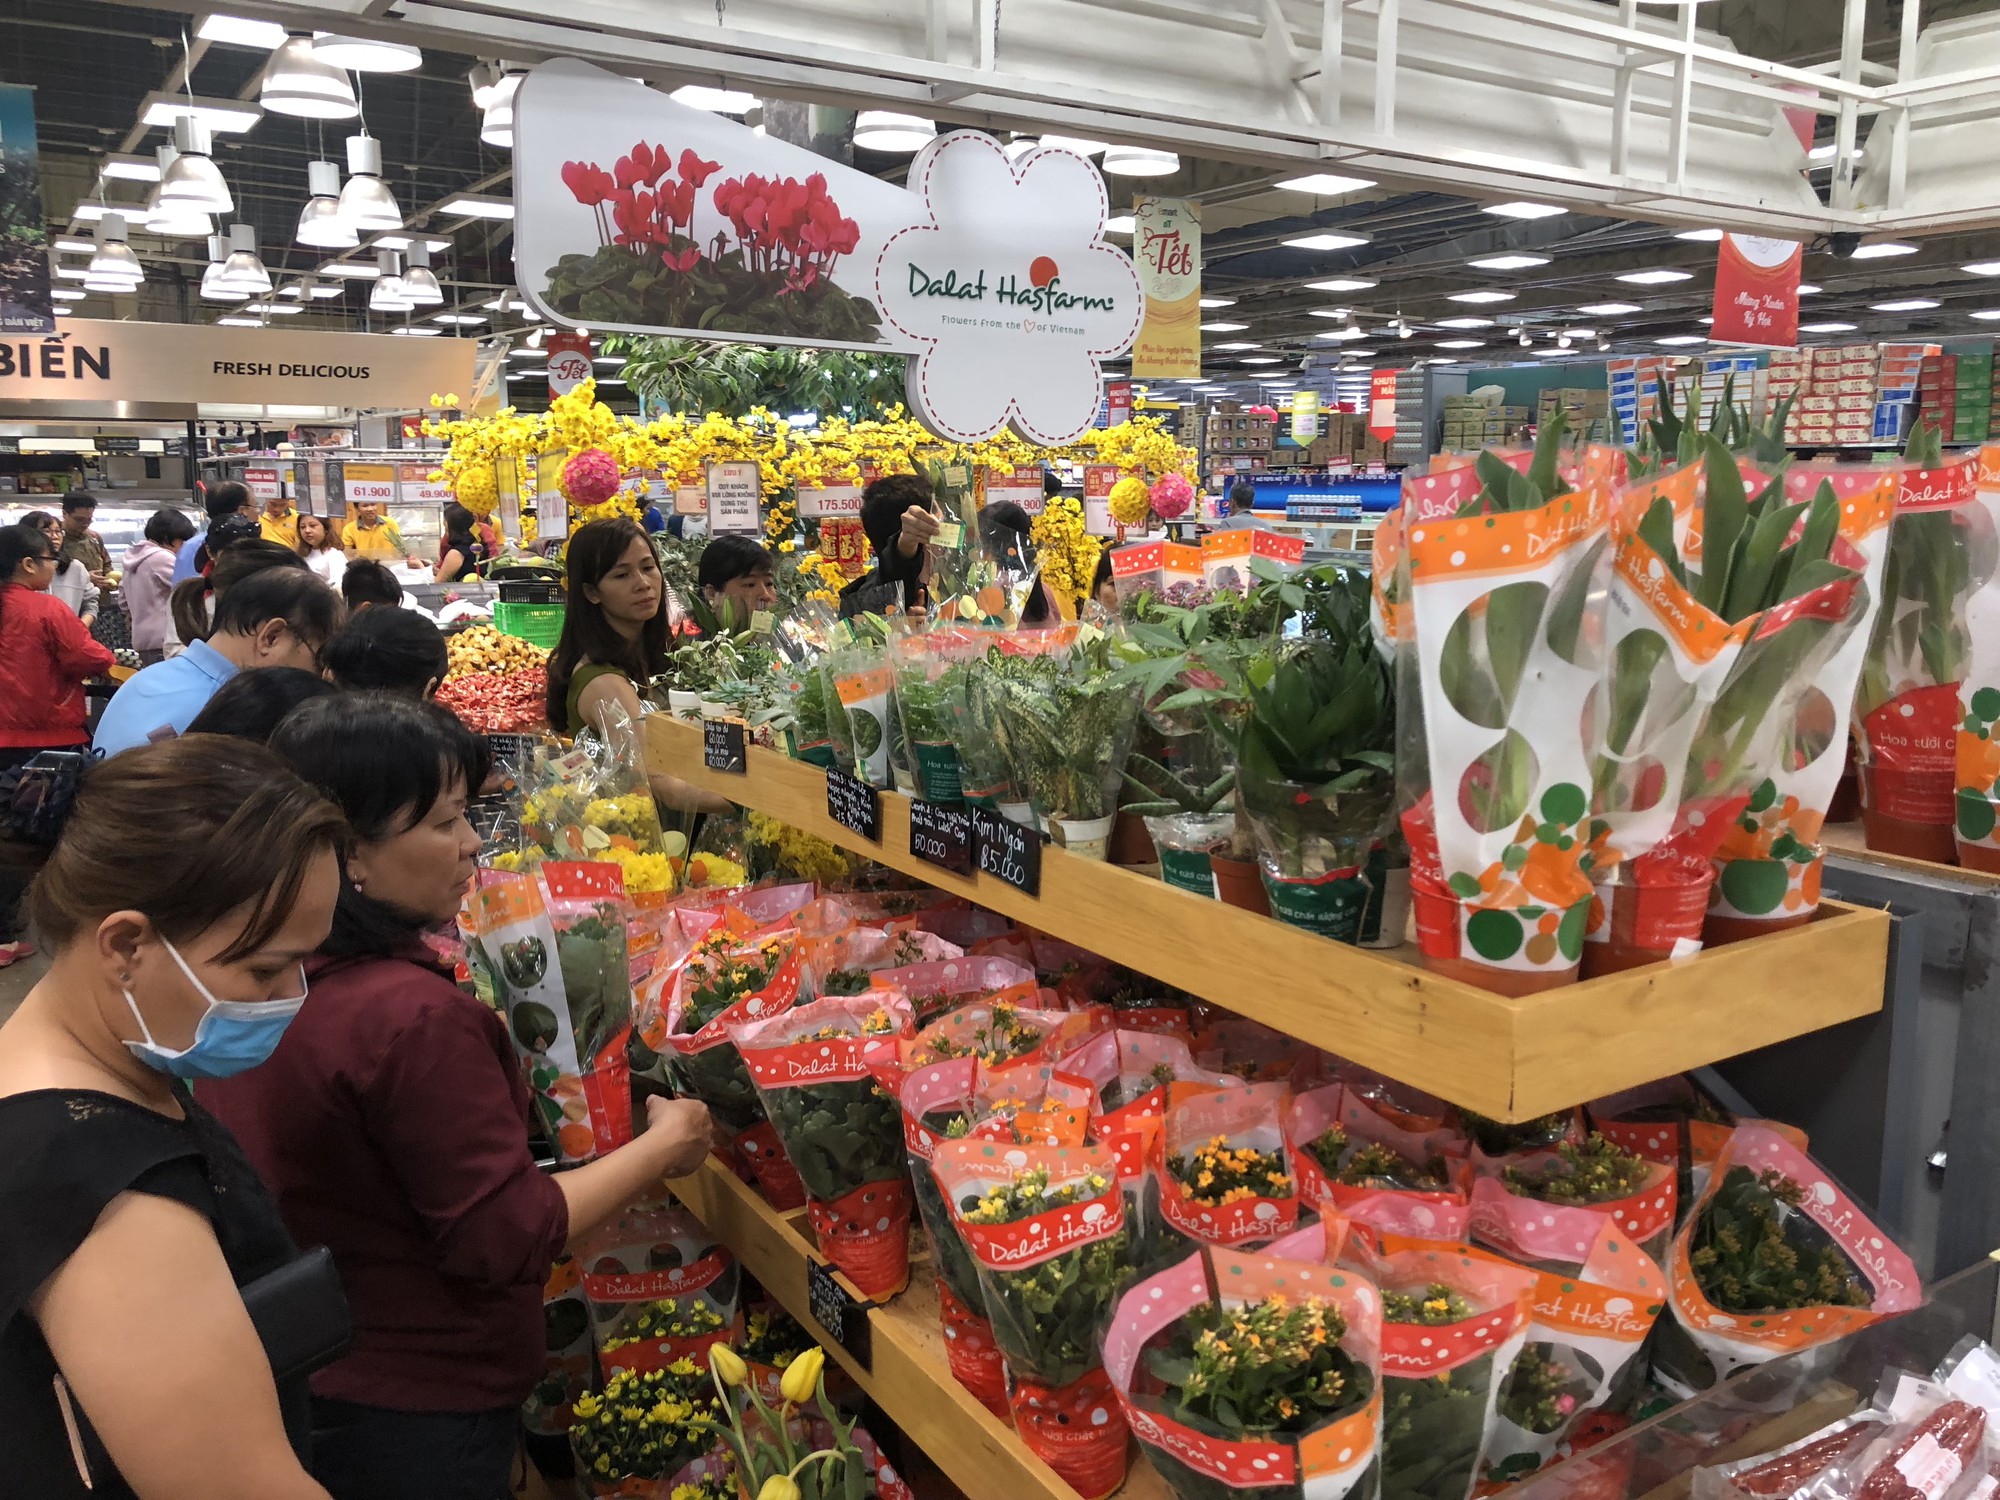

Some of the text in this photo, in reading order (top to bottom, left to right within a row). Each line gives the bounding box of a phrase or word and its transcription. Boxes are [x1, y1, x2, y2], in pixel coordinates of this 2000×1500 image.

[908, 262, 1115, 316] Dalat Hasfarm
[941, 314, 1086, 337] Flowers from the of Vietnam
[213, 361, 371, 379] FRESH DELICIOUS
[549, 359, 590, 380] Tết
[354, 486, 391, 497] 61.900
[419, 489, 453, 500] 49.900
[1899, 481, 1953, 504] Dalat
[817, 498, 862, 511] 175.500
[1527, 525, 1565, 558] Dalat
[1880, 732, 1908, 747] Hoa
[972, 806, 1025, 863] Kim Ngân
[788, 1054, 838, 1078] Dalat
[1170, 1198, 1222, 1239] Dalat
[988, 1228, 1051, 1263] Dalat
[606, 1267, 713, 1295] Dalat Hasfarm
